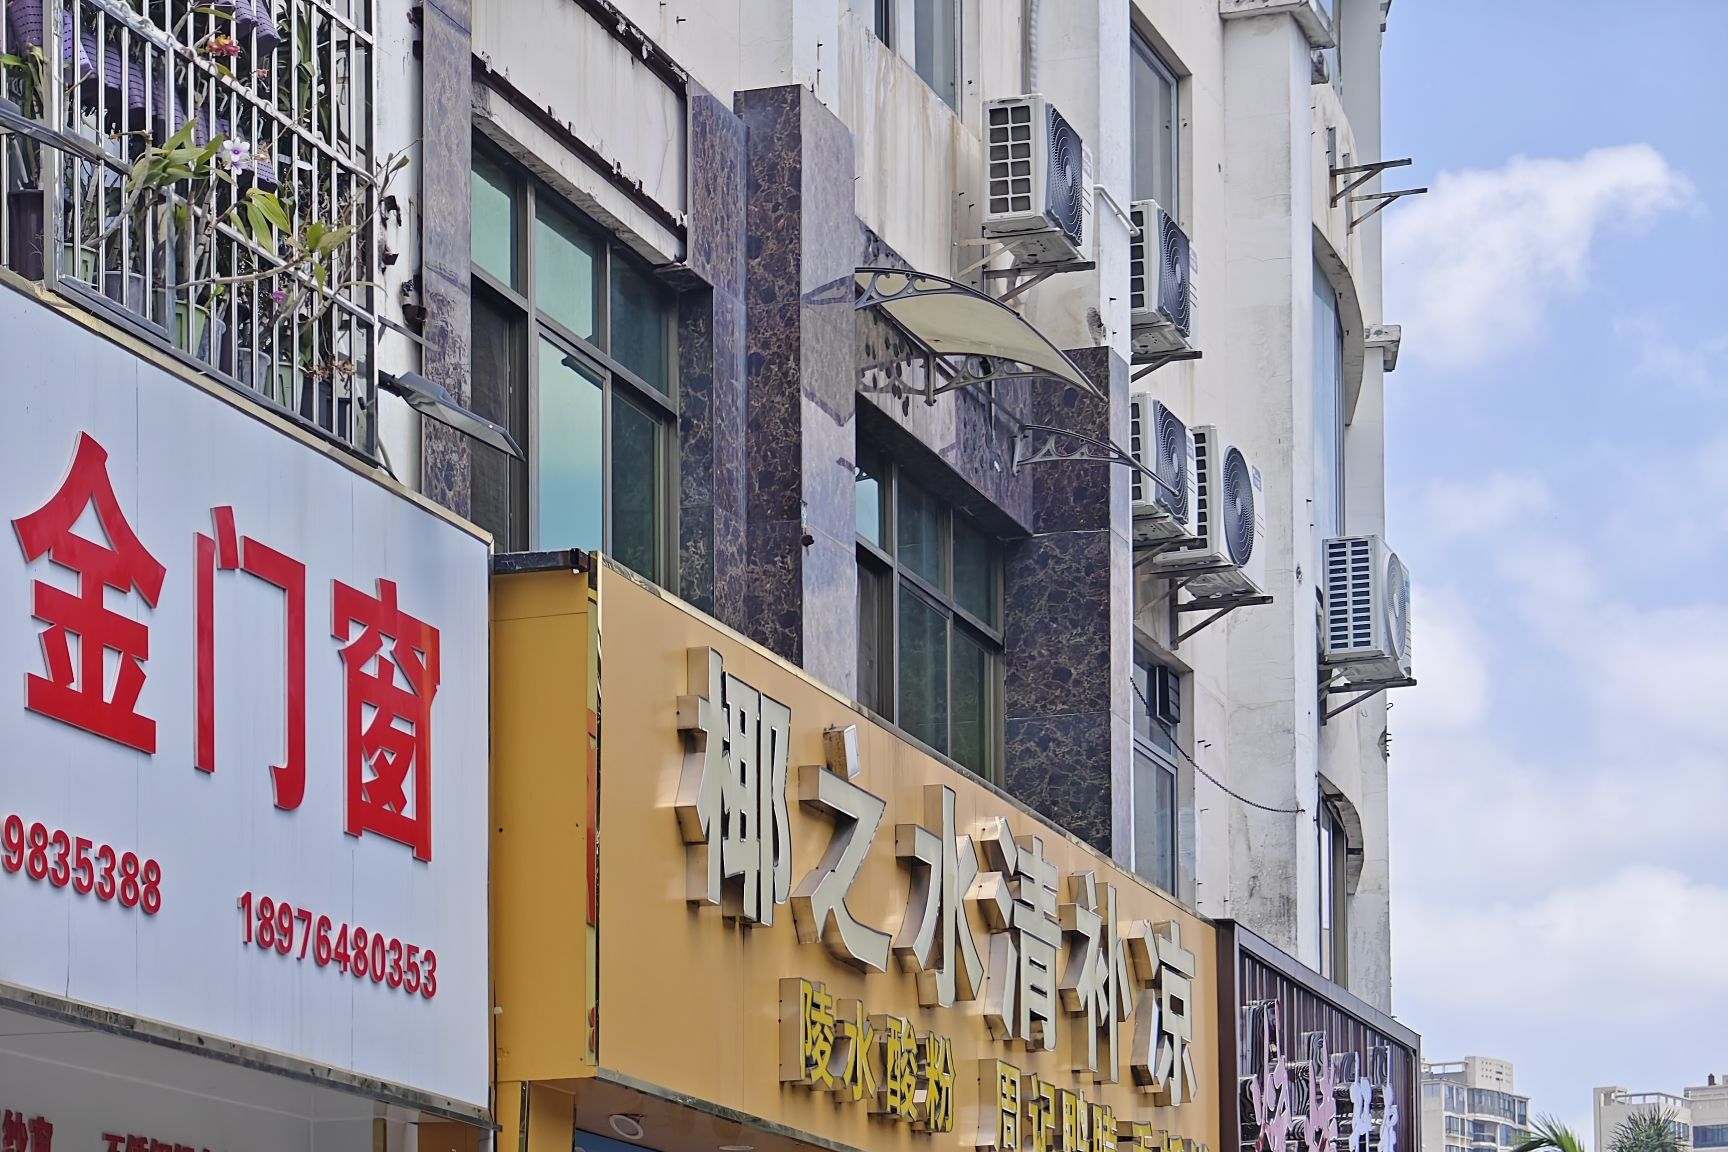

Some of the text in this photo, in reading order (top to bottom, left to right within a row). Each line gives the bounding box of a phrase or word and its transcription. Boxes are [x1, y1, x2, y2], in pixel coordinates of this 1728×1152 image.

[11, 431, 441, 862] 金门窗
[1, 815, 162, 915] 9835388
[688, 646, 1198, 1107] 椰之水清补凉
[237, 891, 438, 999] 18976480353
[799, 977, 956, 1133] 陵水酸粉
